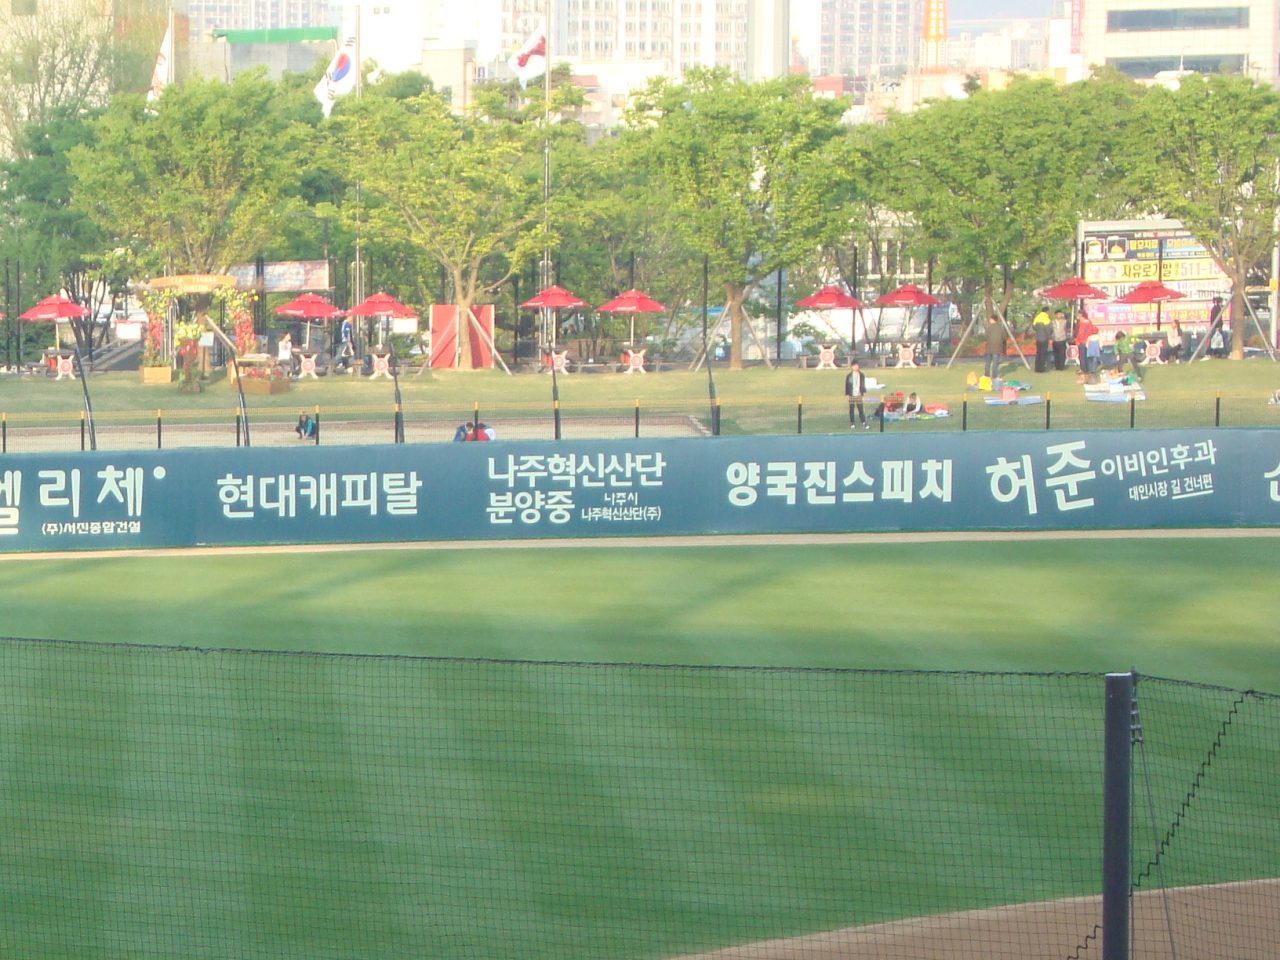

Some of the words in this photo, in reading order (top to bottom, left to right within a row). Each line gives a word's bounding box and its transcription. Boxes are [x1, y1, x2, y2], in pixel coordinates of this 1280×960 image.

[487, 452, 667, 488] 나주혁신산단
[985, 439, 1097, 515] 허준
[1100, 439, 1218, 481] 이비인후과
[216, 471, 423, 519] 현대캐피탈
[604, 492, 638, 506] 나주시
[726, 457, 953, 507] 양국진스피치
[485, 490, 576, 524] 분양중
